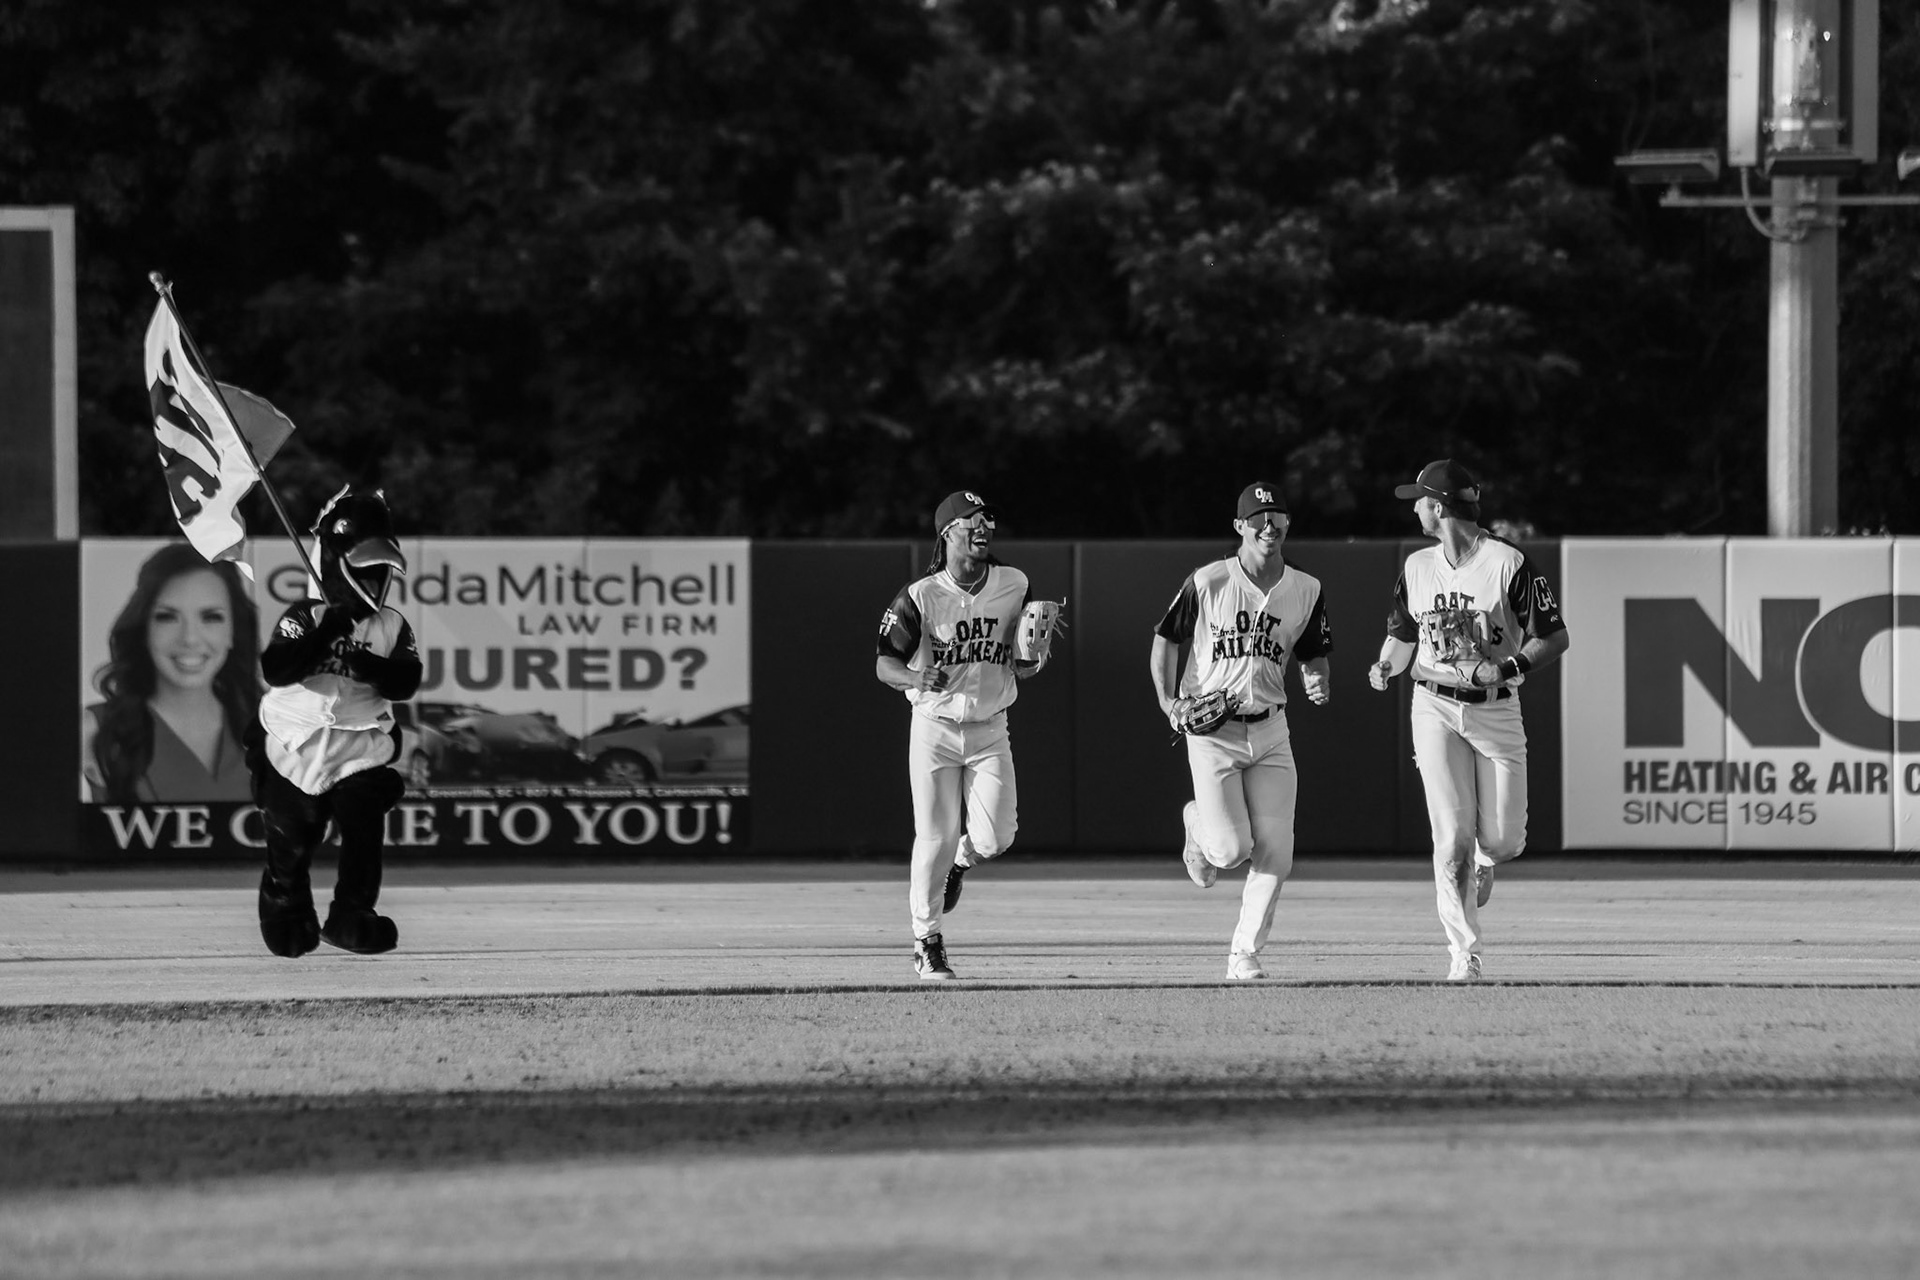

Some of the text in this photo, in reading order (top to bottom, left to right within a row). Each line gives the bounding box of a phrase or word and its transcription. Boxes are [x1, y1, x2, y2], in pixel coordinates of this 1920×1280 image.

[518, 614, 717, 636] LAW FIRM
[955, 617, 999, 642] OAT
[1235, 610, 1282, 637] OAT
[417, 647, 709, 692] JURED?
[1623, 760, 1777, 795] HEATING
[1788, 760, 1818, 795] &
[1826, 761, 1889, 796] AIR
[101, 801, 733, 850] WE CE TO YOU!
[1623, 801, 1818, 826] SINCE 1945
